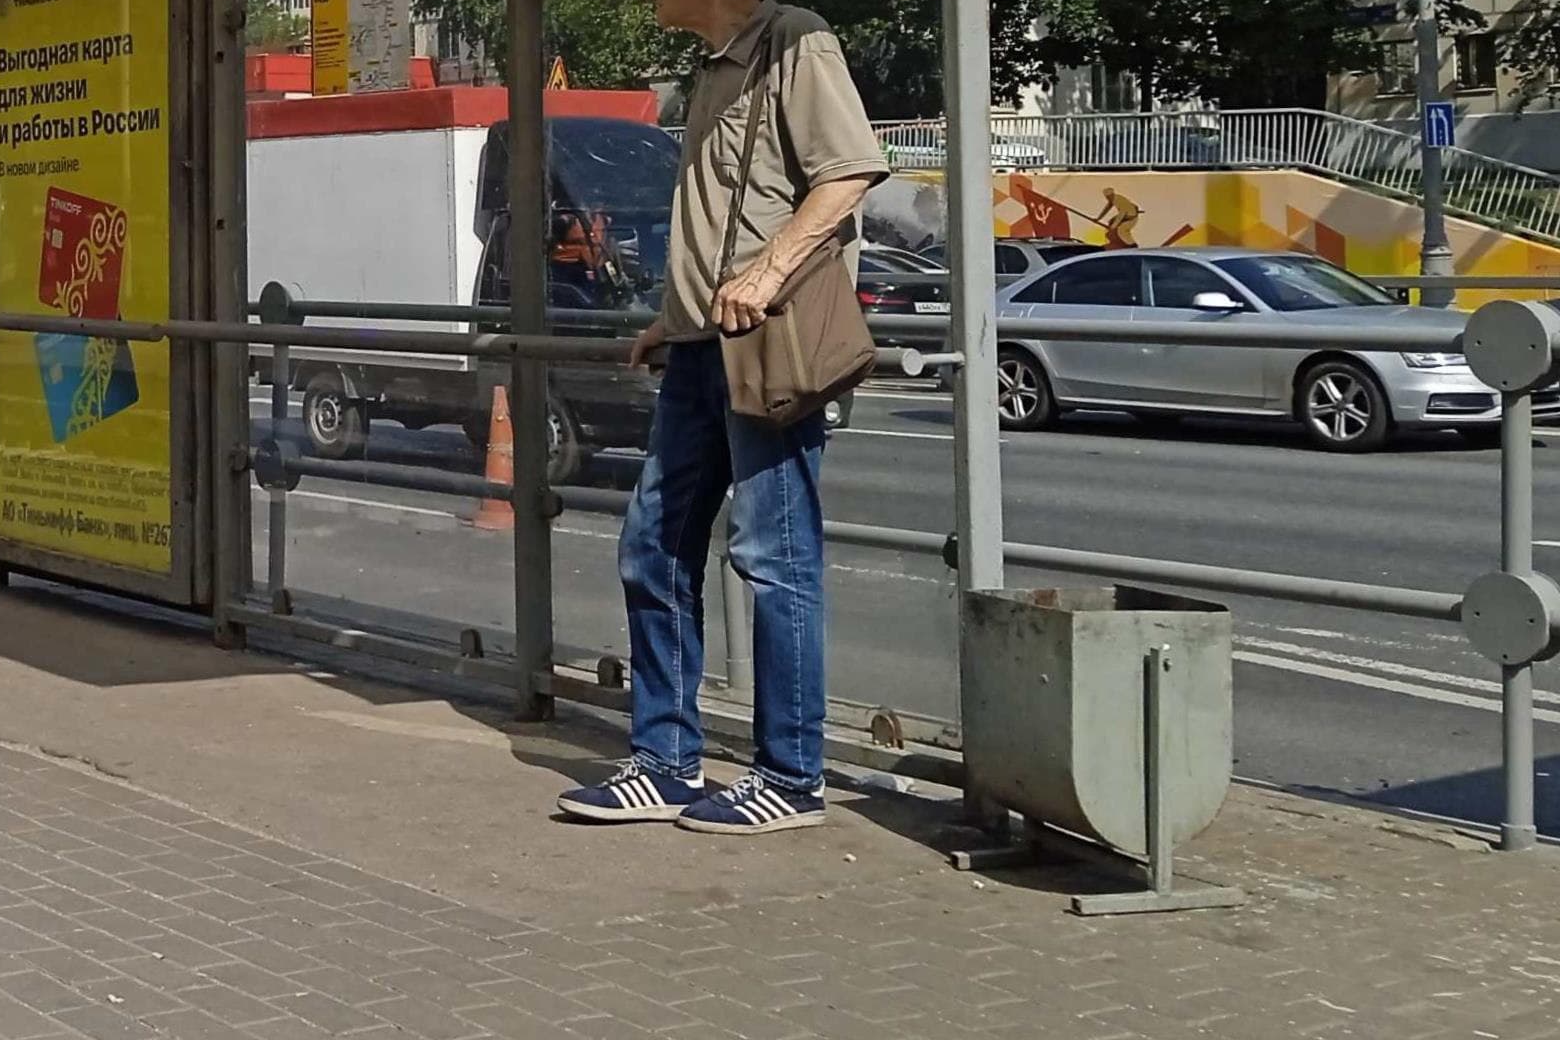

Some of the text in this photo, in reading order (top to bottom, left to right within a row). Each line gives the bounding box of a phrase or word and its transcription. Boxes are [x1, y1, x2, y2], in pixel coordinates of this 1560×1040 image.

[82, 33, 133, 65] карта
[30, 78, 88, 106] жизни
[12, 113, 74, 149] работы
[78, 116, 88, 137] в
[92, 108, 160, 135] России
[7, 161, 37, 177] новом
[38, 156, 80, 176] дизайне
[50, 196, 82, 216] TINKOFF
[2, 499, 15, 522] АО
